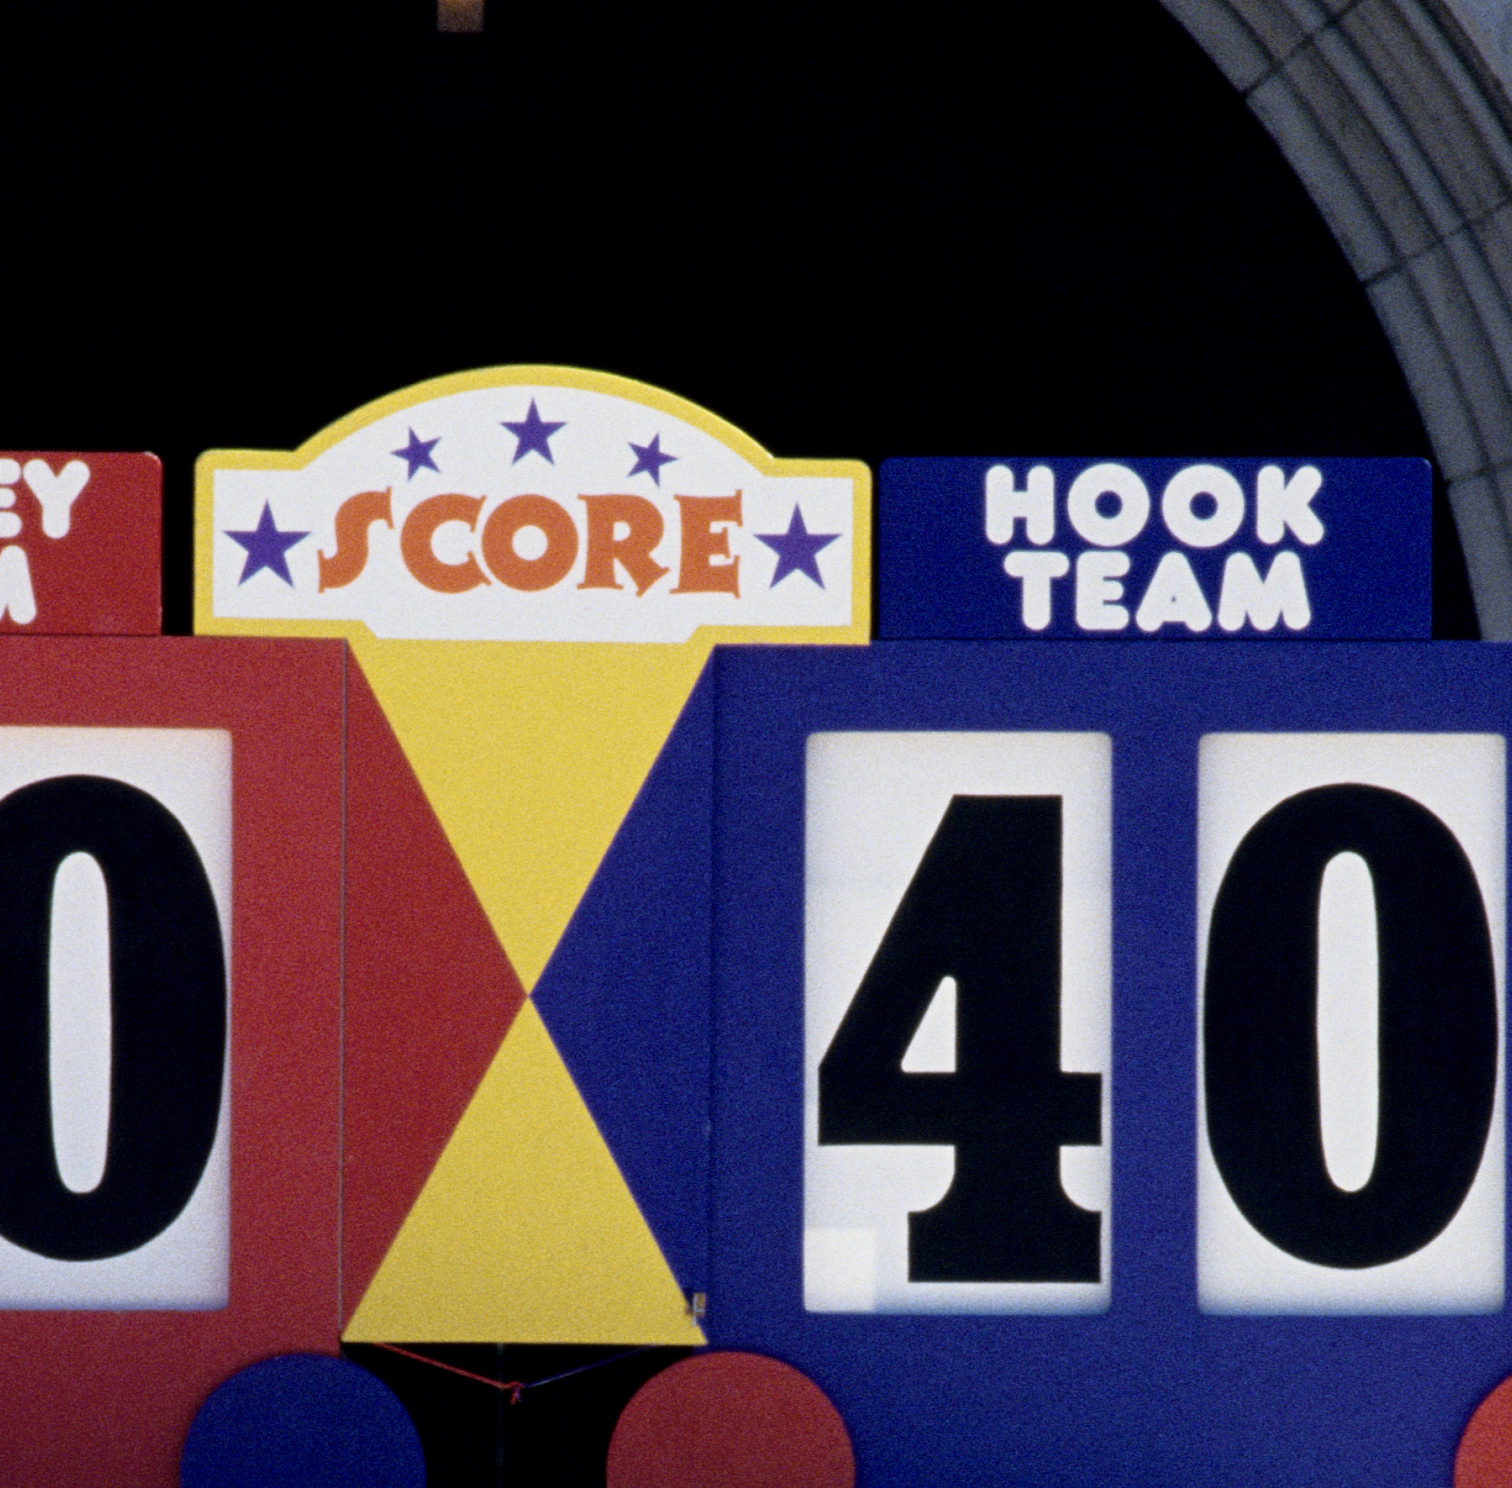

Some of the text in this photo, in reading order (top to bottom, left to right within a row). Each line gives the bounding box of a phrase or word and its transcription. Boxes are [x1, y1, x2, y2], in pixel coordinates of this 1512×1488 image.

[317, 486, 744, 600] SCORE
[985, 463, 1325, 548] HOOK
[1003, 550, 1312, 633] TEAM
